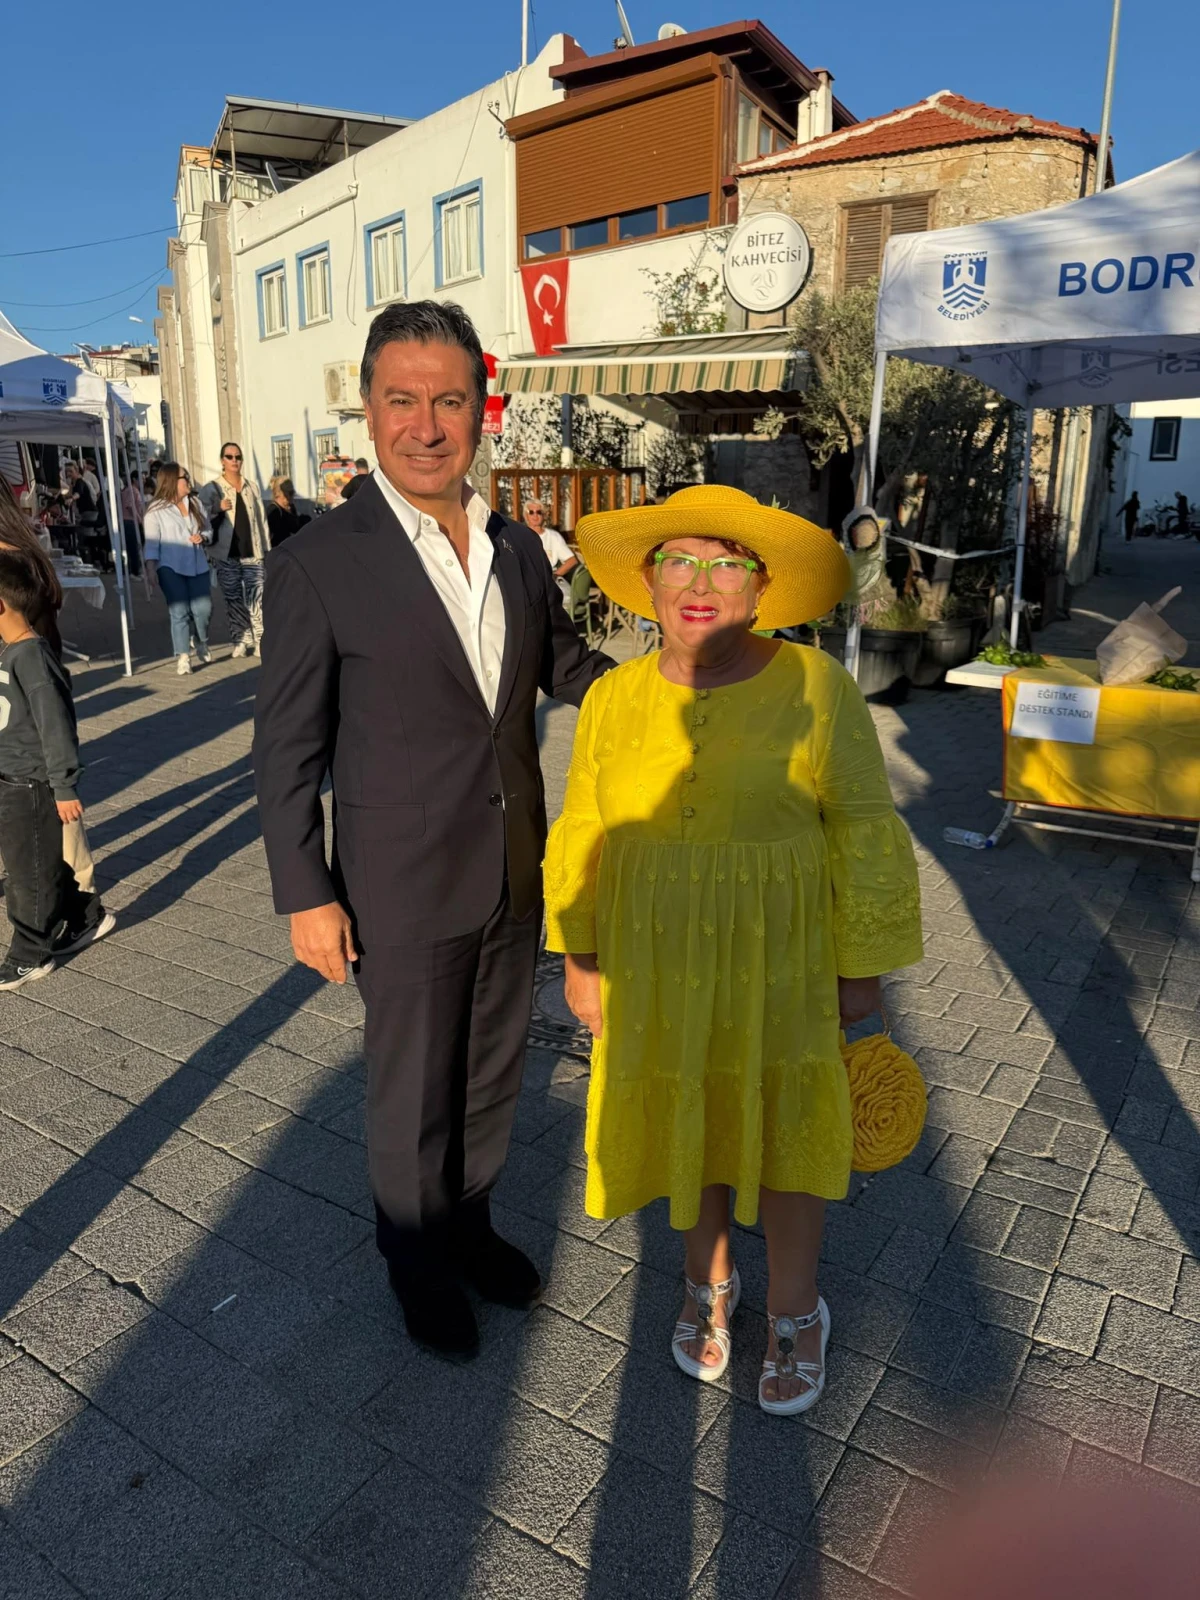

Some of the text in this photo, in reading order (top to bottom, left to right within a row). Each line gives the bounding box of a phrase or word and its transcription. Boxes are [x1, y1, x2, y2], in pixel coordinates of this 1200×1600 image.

[747, 231, 784, 247] BİTEZ
[731, 245, 802, 267] KAHVECİSİ
[1058, 252, 1200, 297] BODR
[937, 300, 990, 321] BELEDİYESİ
[1037, 689, 1079, 702] EĞİTİME
[1019, 703, 1094, 719] DESTEK STANDI
